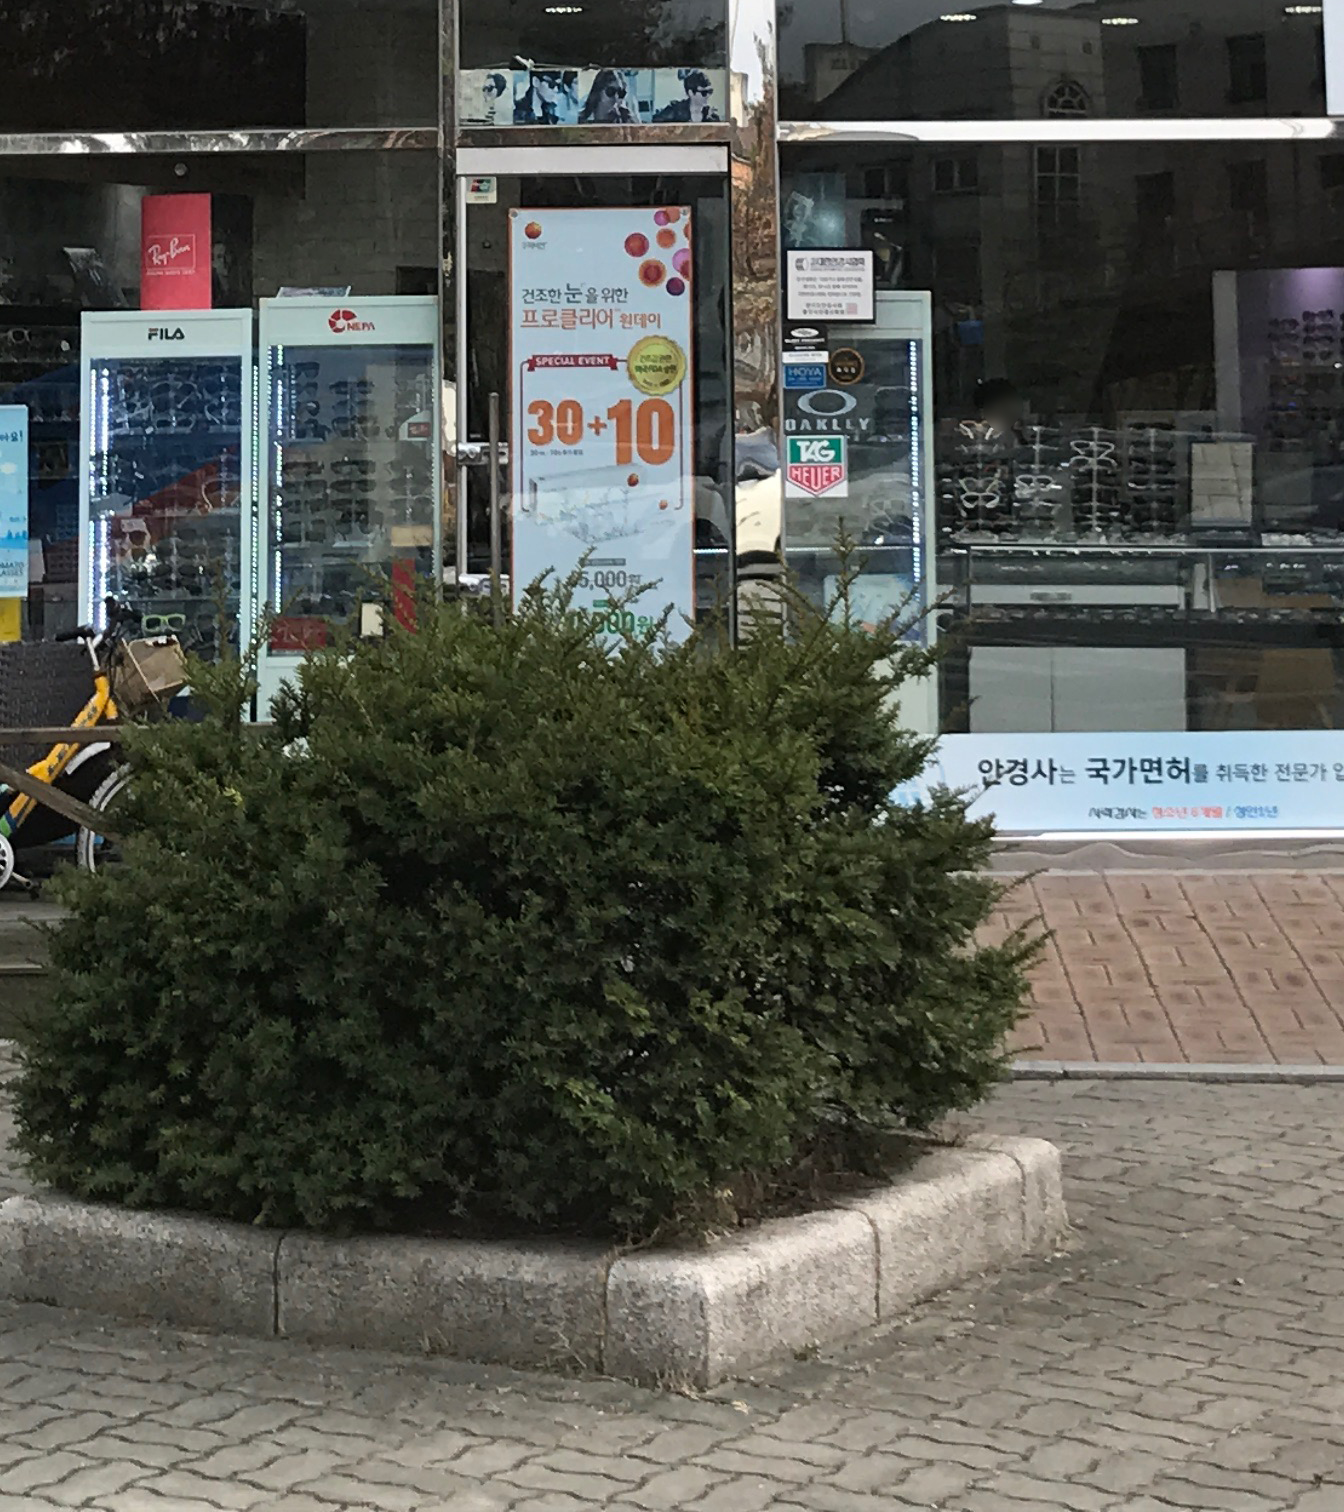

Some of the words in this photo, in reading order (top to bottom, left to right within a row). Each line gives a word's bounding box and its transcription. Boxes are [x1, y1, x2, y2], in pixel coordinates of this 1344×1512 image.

[522, 288, 562, 304] 건조한
[601, 288, 628, 304] 위한
[619, 313, 661, 329] 원데이
[147, 327, 185, 341] FILA
[535, 356, 574, 366] SPECIAL
[578, 355, 610, 366] EVENT
[788, 368, 821, 376] HOYA
[796, 441, 836, 462] TAG
[791, 465, 843, 490] HEUER
[1085, 756, 1209, 785] 국가면허를
[1216, 763, 1268, 783] 취득한
[1274, 762, 1327, 782] 전문가
